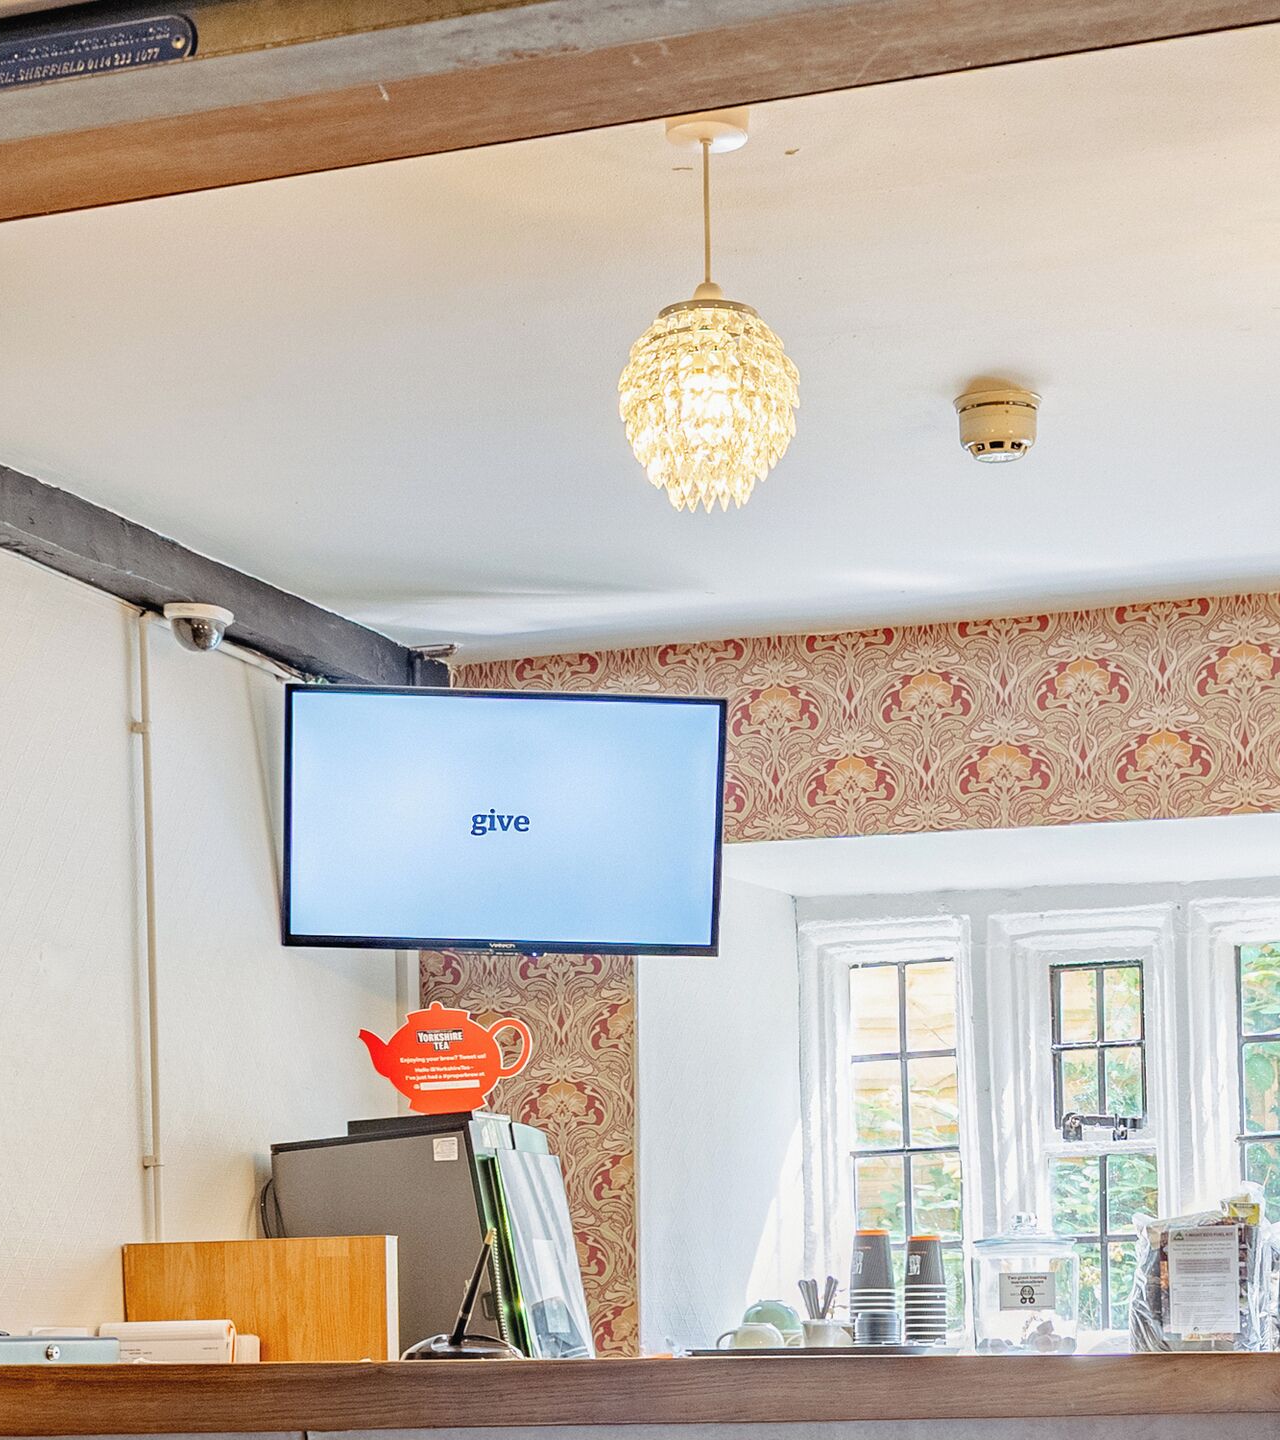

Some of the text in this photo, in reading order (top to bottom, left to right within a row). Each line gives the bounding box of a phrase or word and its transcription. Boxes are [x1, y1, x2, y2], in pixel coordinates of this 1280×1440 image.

[19, 61, 85, 81] SHEFFIELD
[470, 808, 530, 836] give
[417, 1032, 463, 1042] YORKSHIRE
[434, 1042, 450, 1050] TEA
